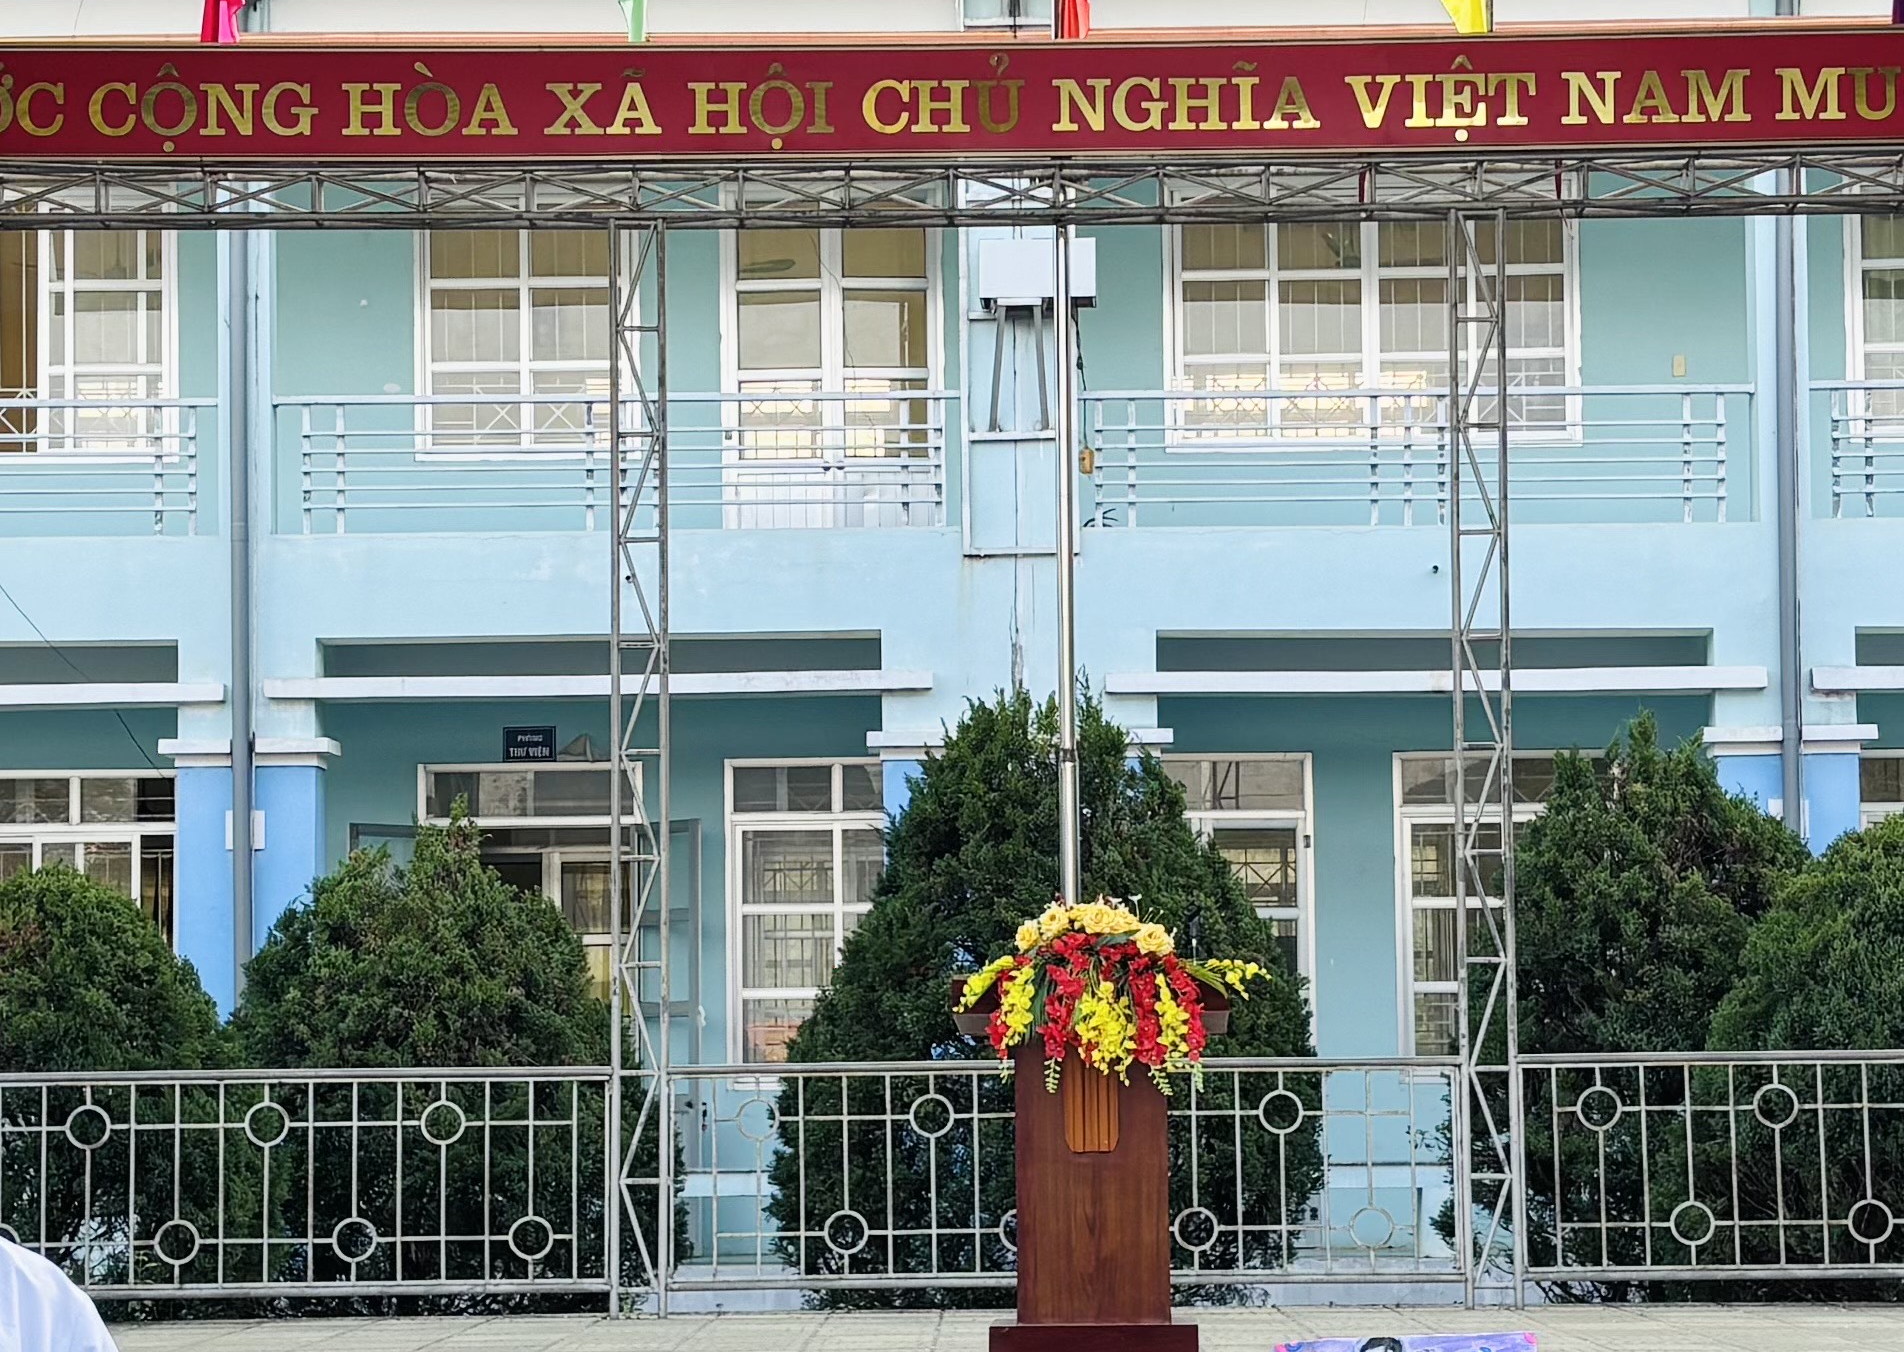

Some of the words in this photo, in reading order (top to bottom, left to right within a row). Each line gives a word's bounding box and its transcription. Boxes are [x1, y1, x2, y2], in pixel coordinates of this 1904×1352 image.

[89, 62, 319, 153] CỘNG
[342, 61, 519, 137] HÒA
[544, 67, 664, 137] XÃ
[687, 61, 835, 151] HỘI
[862, 52, 1025, 136] CHỦ
[1051, 60, 1322, 133] NGHĨA
[1344, 54, 1537, 143] VIỆT
[1561, 67, 1753, 127] NAM
